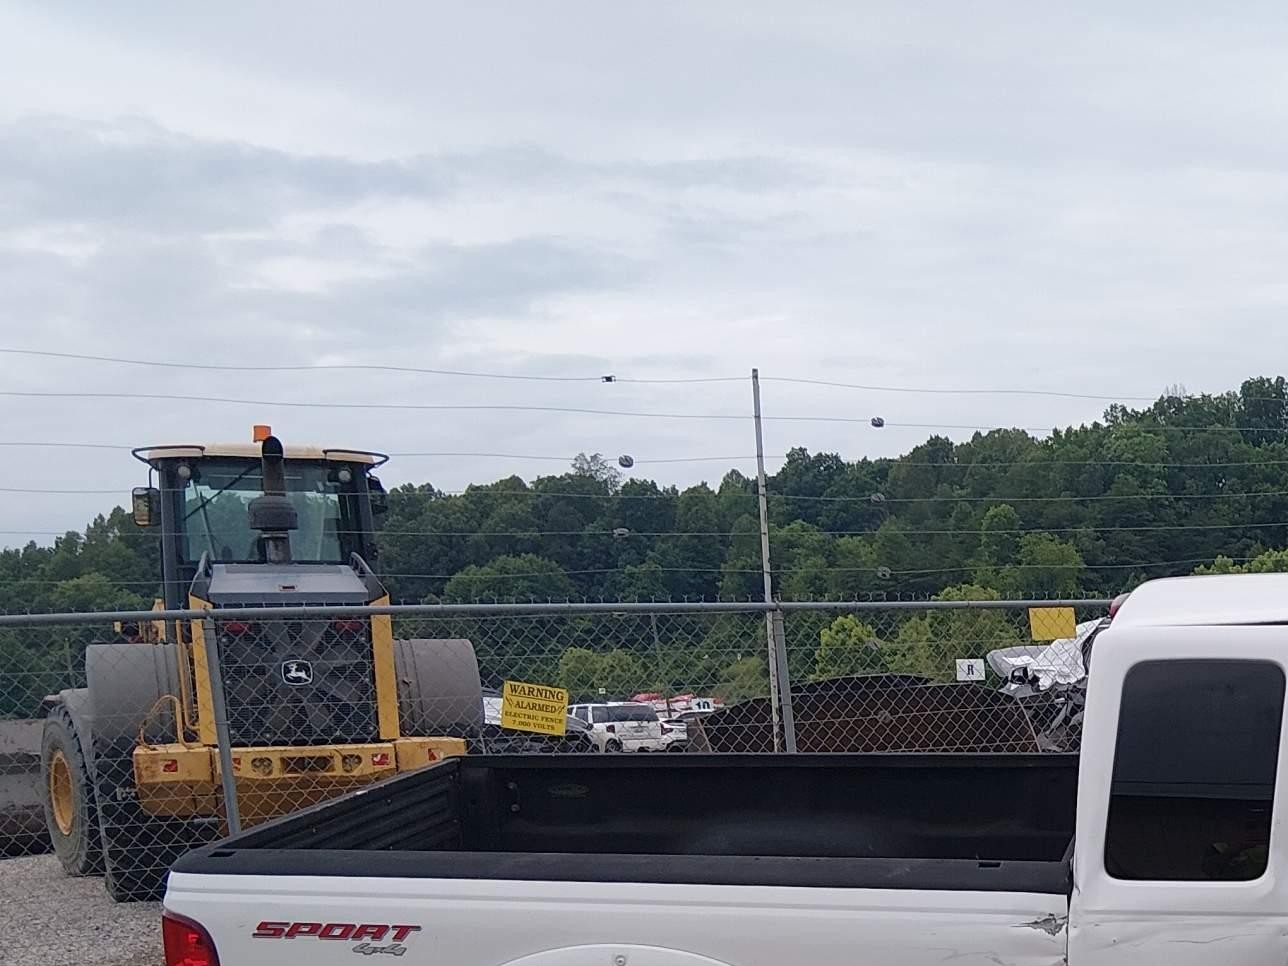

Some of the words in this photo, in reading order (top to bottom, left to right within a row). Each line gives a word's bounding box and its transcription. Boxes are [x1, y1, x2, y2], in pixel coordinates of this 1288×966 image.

[967, 664, 974, 675] R
[509, 683, 564, 701] WARNING
[515, 701, 556, 713] ALARMED
[505, 711, 540, 721] ELECTRIC
[541, 716, 563, 724] FENCE
[533, 722, 555, 731] VOLTS
[252, 920, 422, 942] SPORT
[351, 942, 407, 957] 4x4
